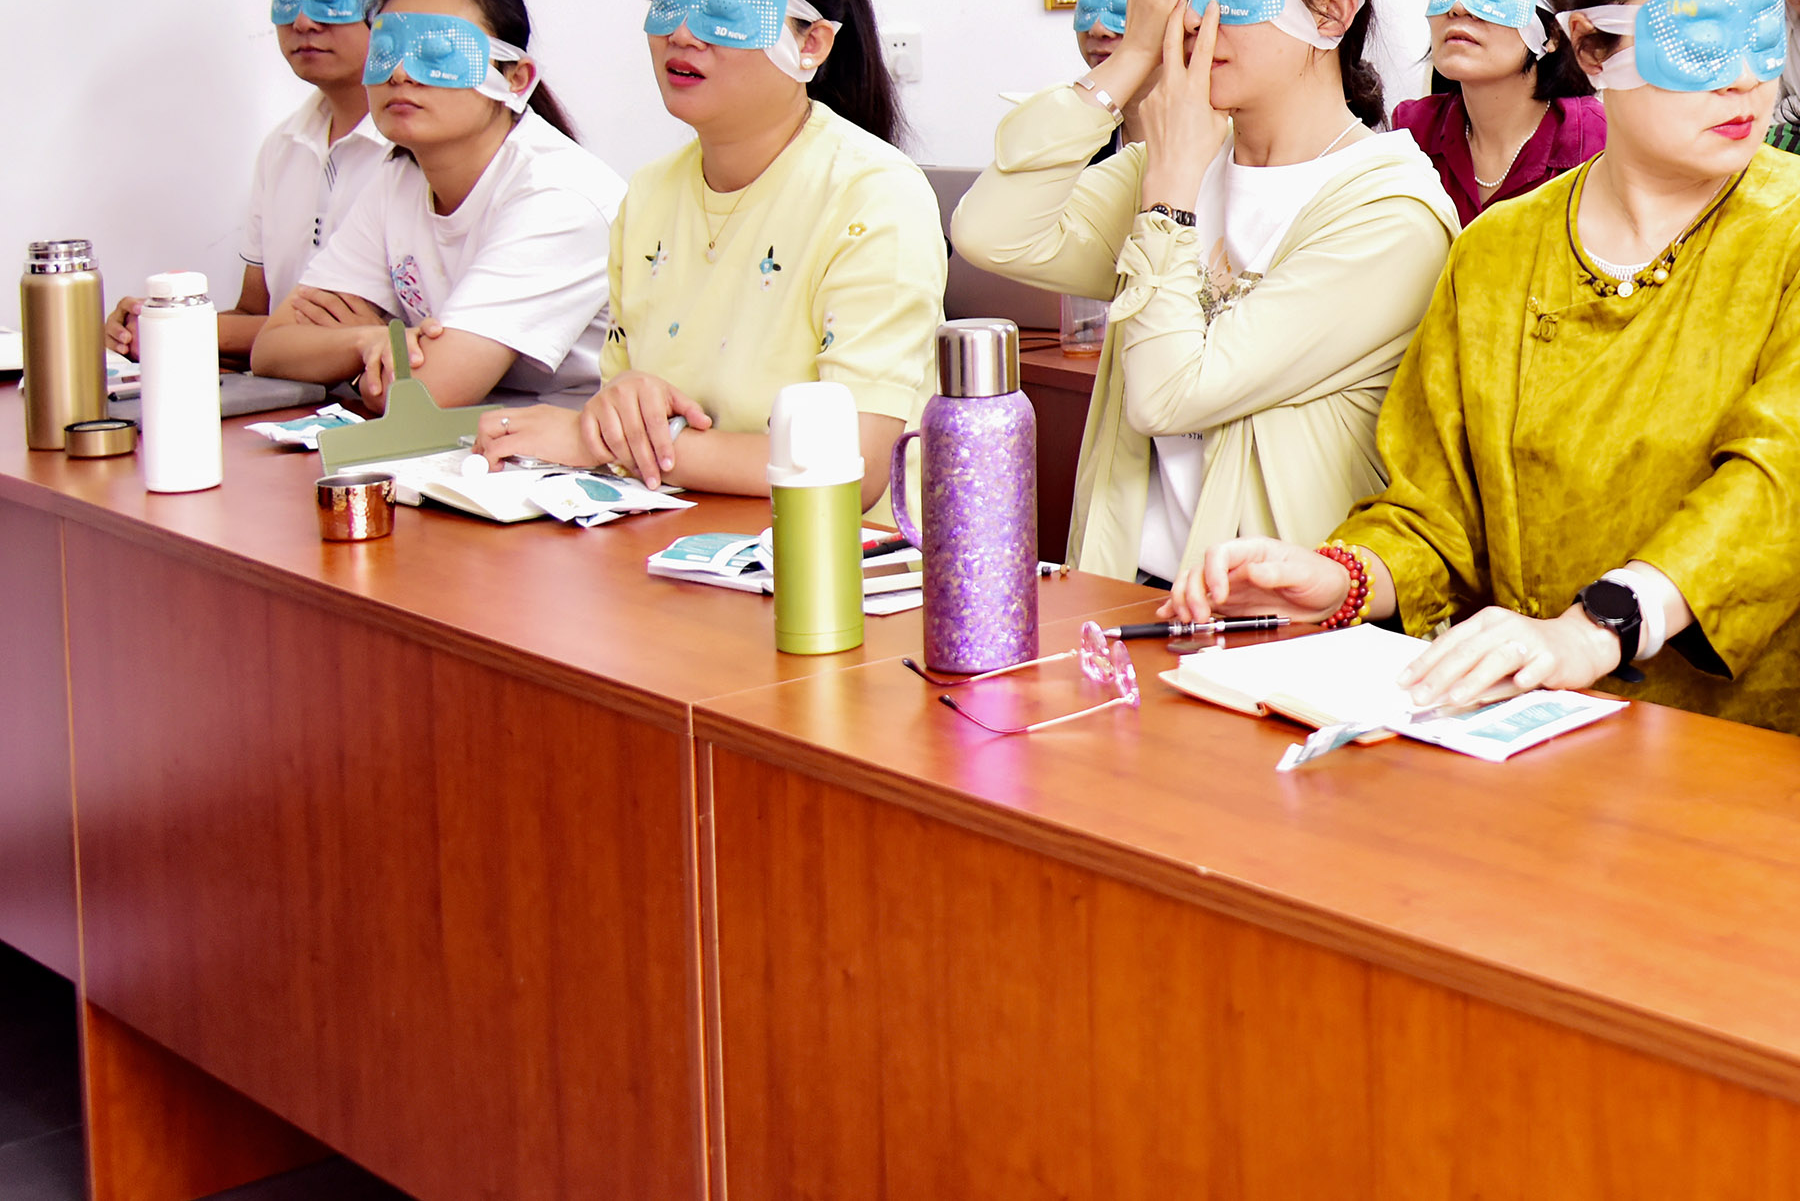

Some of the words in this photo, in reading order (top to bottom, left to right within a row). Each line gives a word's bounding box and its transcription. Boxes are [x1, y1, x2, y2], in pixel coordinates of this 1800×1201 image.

[1220, 5, 1229, 15] 3D
[1231, 8, 1249, 17] NEW
[714, 26, 727, 37] 3D
[728, 30, 748, 41] NEW
